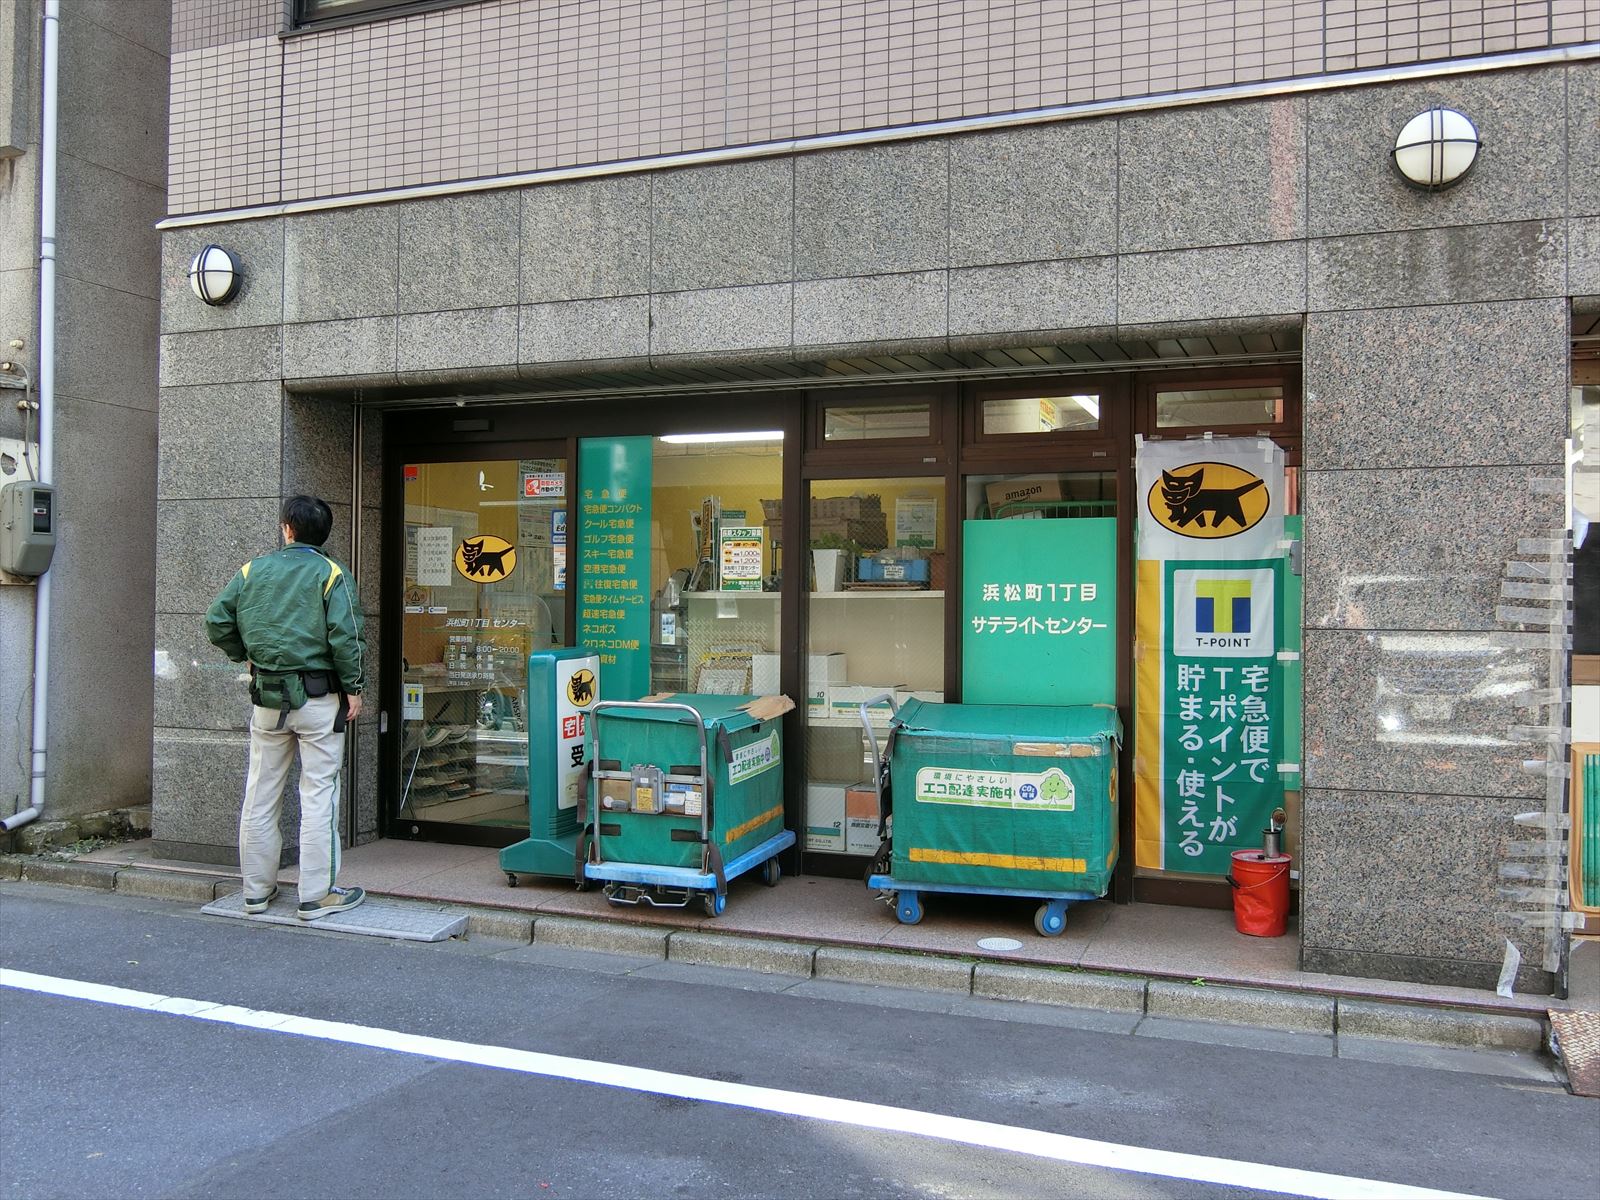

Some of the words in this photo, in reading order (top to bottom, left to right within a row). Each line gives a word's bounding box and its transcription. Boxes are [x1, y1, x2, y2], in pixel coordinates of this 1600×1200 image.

[1005, 484, 1042, 500] amazon
[583, 504, 643, 514] 宅急便コンパクト
[584, 519, 635, 529] クール宅急便
[584, 534, 634, 544] ゴルフ宅急便
[584, 549, 634, 559] スキー宅急便
[583, 564, 626, 574] 空港宅急便
[982, 583, 1097, 602] 浜松町1丁目
[583, 594, 645, 604] 宅急便タイムサービス
[493, 618, 526, 627] センター
[972, 616, 1107, 635] サテライトセンター
[583, 624, 616, 634] ネコポス
[582, 639, 639, 650] クロネコDM便
[1195, 637, 1251, 648] T-POINT
[1239, 664, 1270, 783] 宅急便で
[1176, 664, 1206, 857] 貯まる・使える
[1208, 667, 1239, 843] Tポイントが
[933, 772, 1008, 784] 環境にやさしい
[923, 782, 1016, 799] エコ配達実施中
